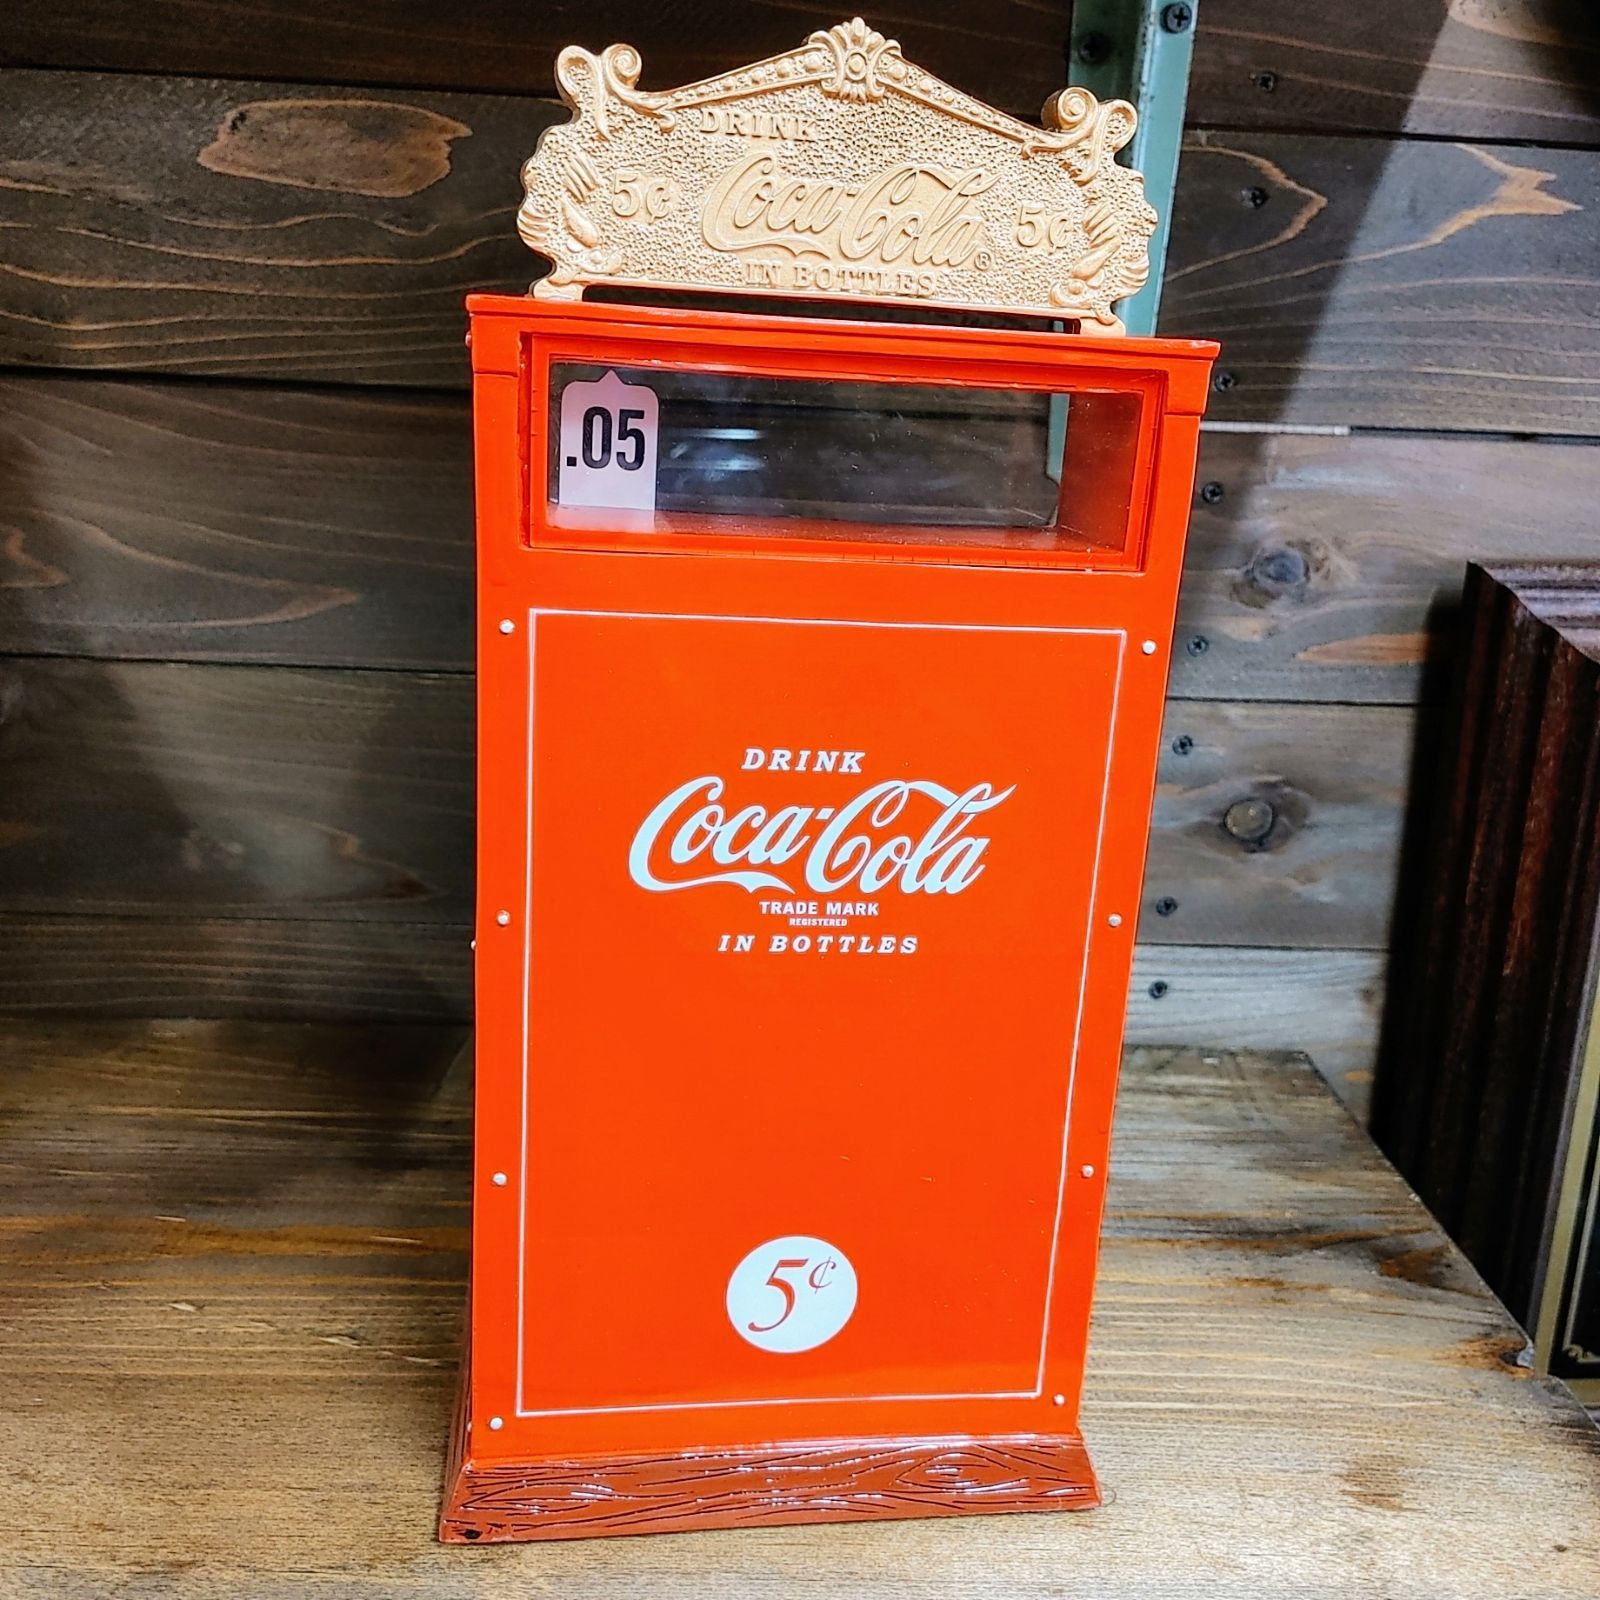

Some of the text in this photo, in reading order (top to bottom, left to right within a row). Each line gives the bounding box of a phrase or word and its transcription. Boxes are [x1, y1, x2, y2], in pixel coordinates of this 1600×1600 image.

[699, 108, 820, 142] DRINK
[745, 261, 939, 298] IN BOTTLES
[565, 405, 646, 472] .05
[741, 747, 866, 773] DRINK
[627, 775, 1018, 895] Coca-Cola
[759, 901, 880, 916] TRADE MARK
[788, 917, 849, 927] REGISTERED
[717, 934, 919, 954] IN BOTTLES
